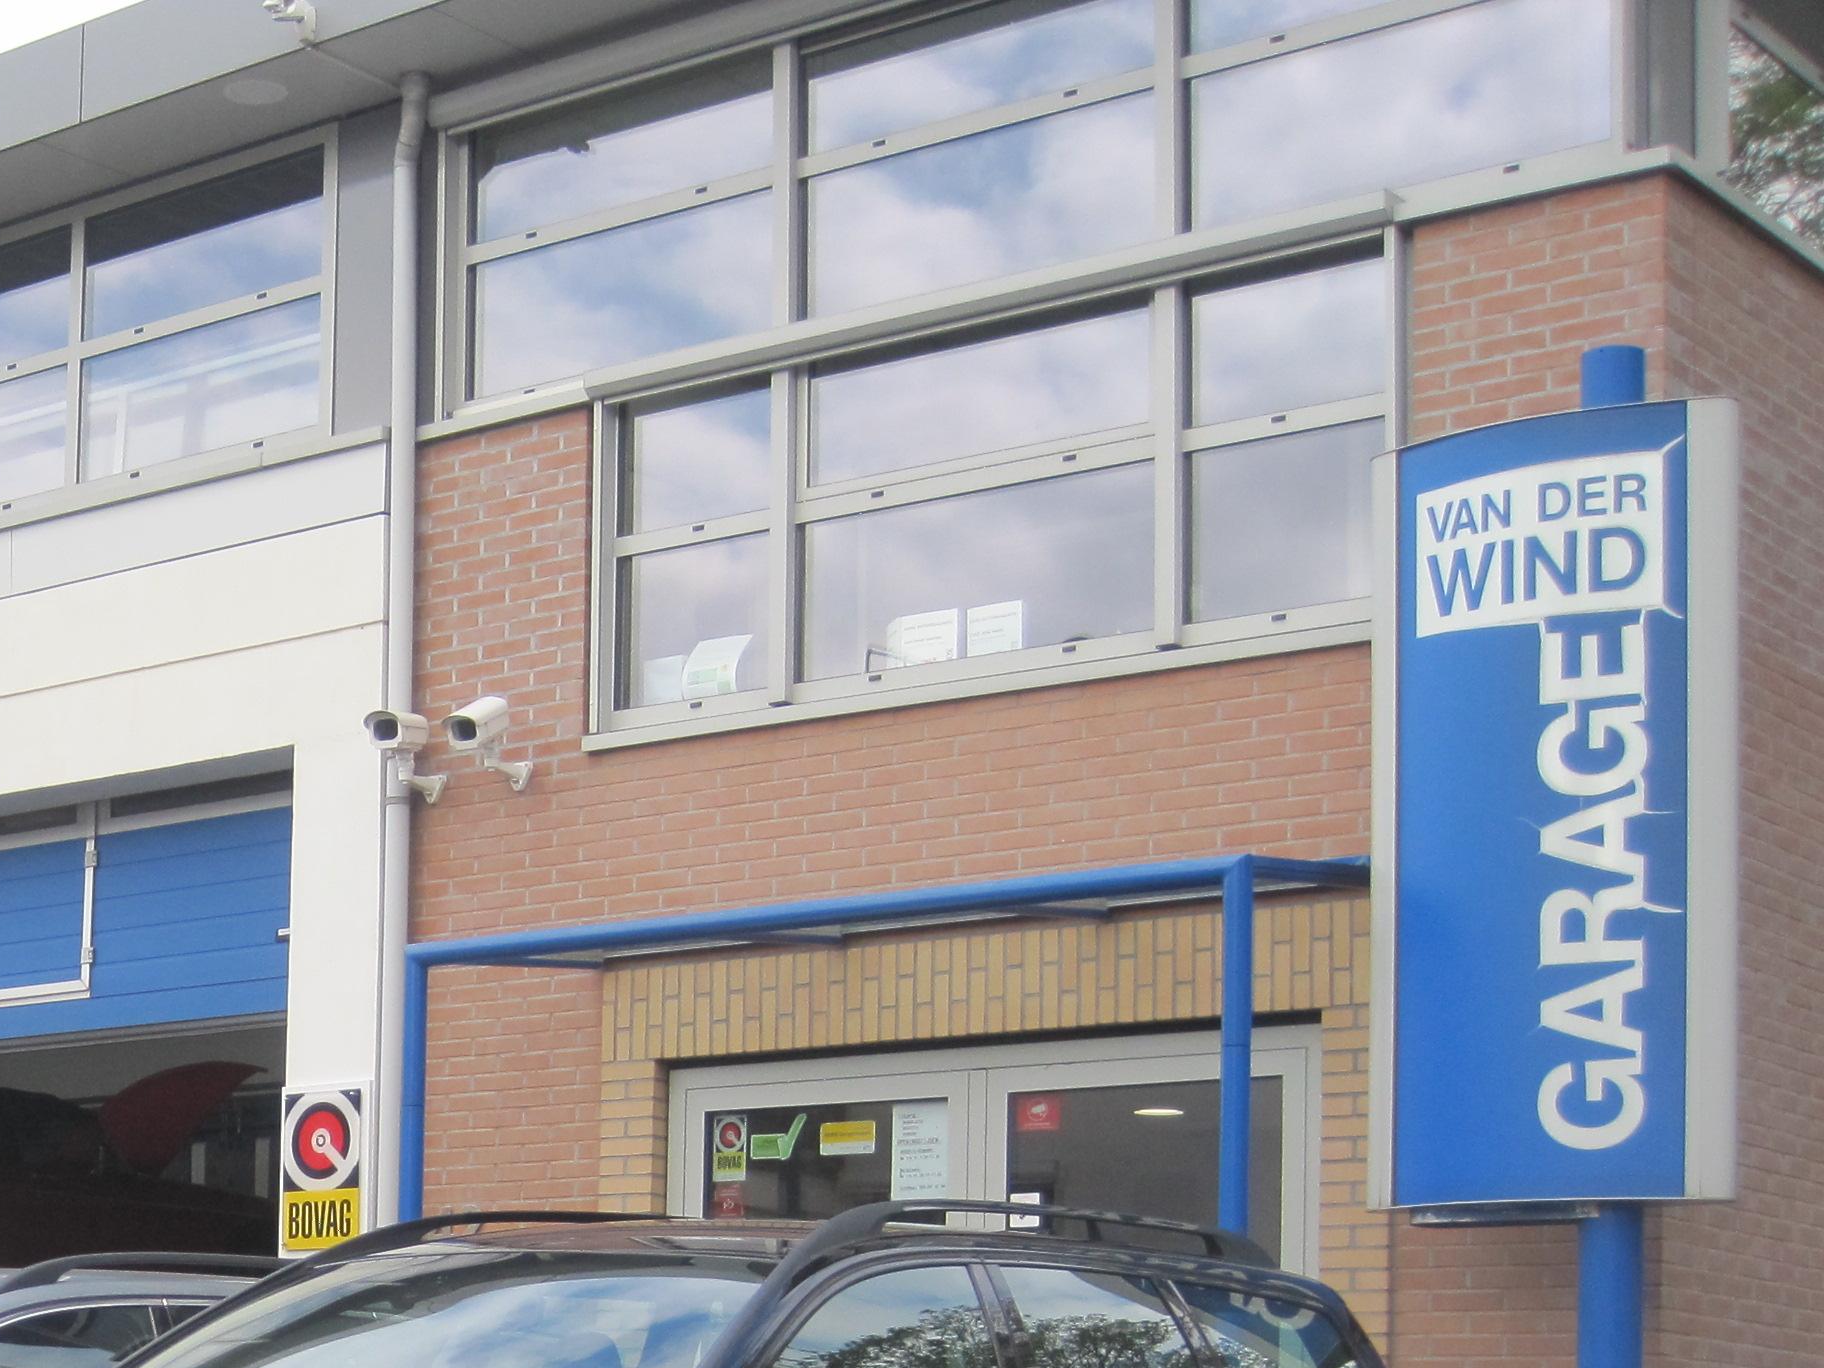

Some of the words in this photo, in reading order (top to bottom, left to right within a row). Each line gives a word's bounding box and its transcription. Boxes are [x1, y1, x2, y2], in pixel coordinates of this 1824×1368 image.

[1426, 489, 1511, 543] VAN
[1537, 473, 1647, 523] DER
[1426, 526, 1646, 618] WIND
[1537, 609, 1648, 1151] GARAGE
[288, 1199, 352, 1239] BOVAG
